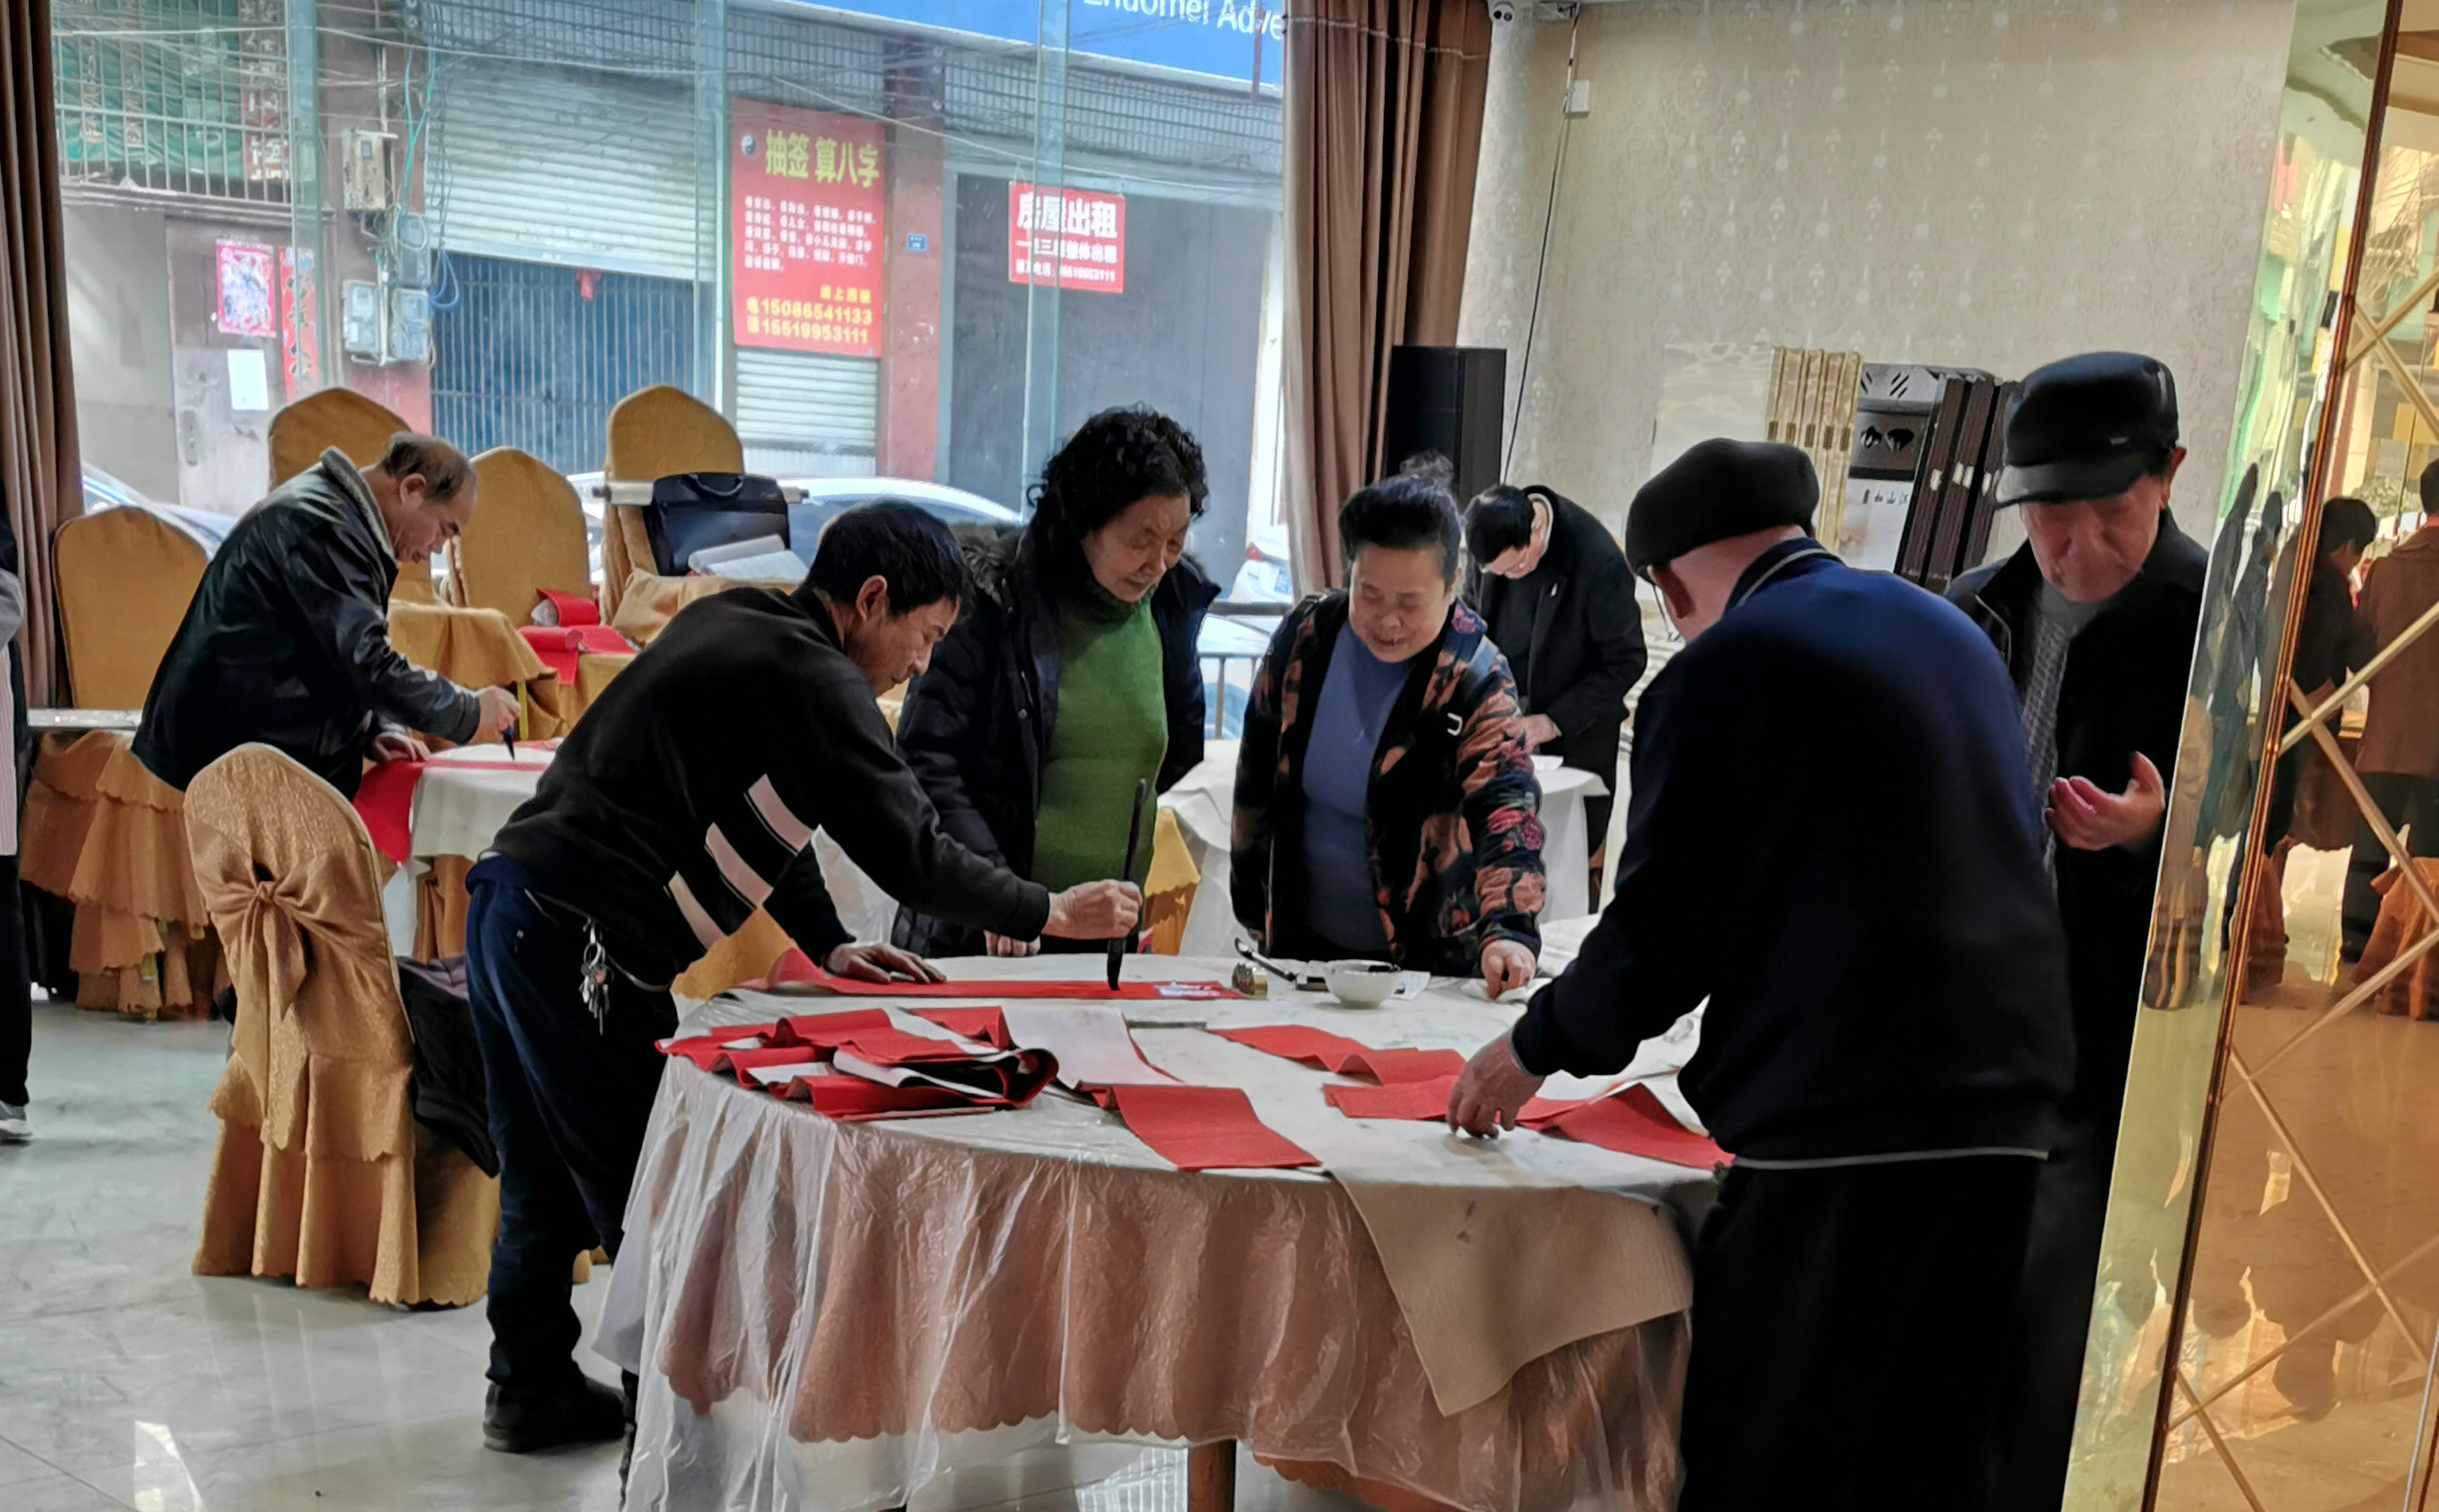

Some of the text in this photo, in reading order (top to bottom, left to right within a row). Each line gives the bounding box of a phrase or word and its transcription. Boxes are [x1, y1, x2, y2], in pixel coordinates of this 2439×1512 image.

[765, 127, 879, 188] 抽签 算八字
[1017, 191, 1117, 239] 房屋出租
